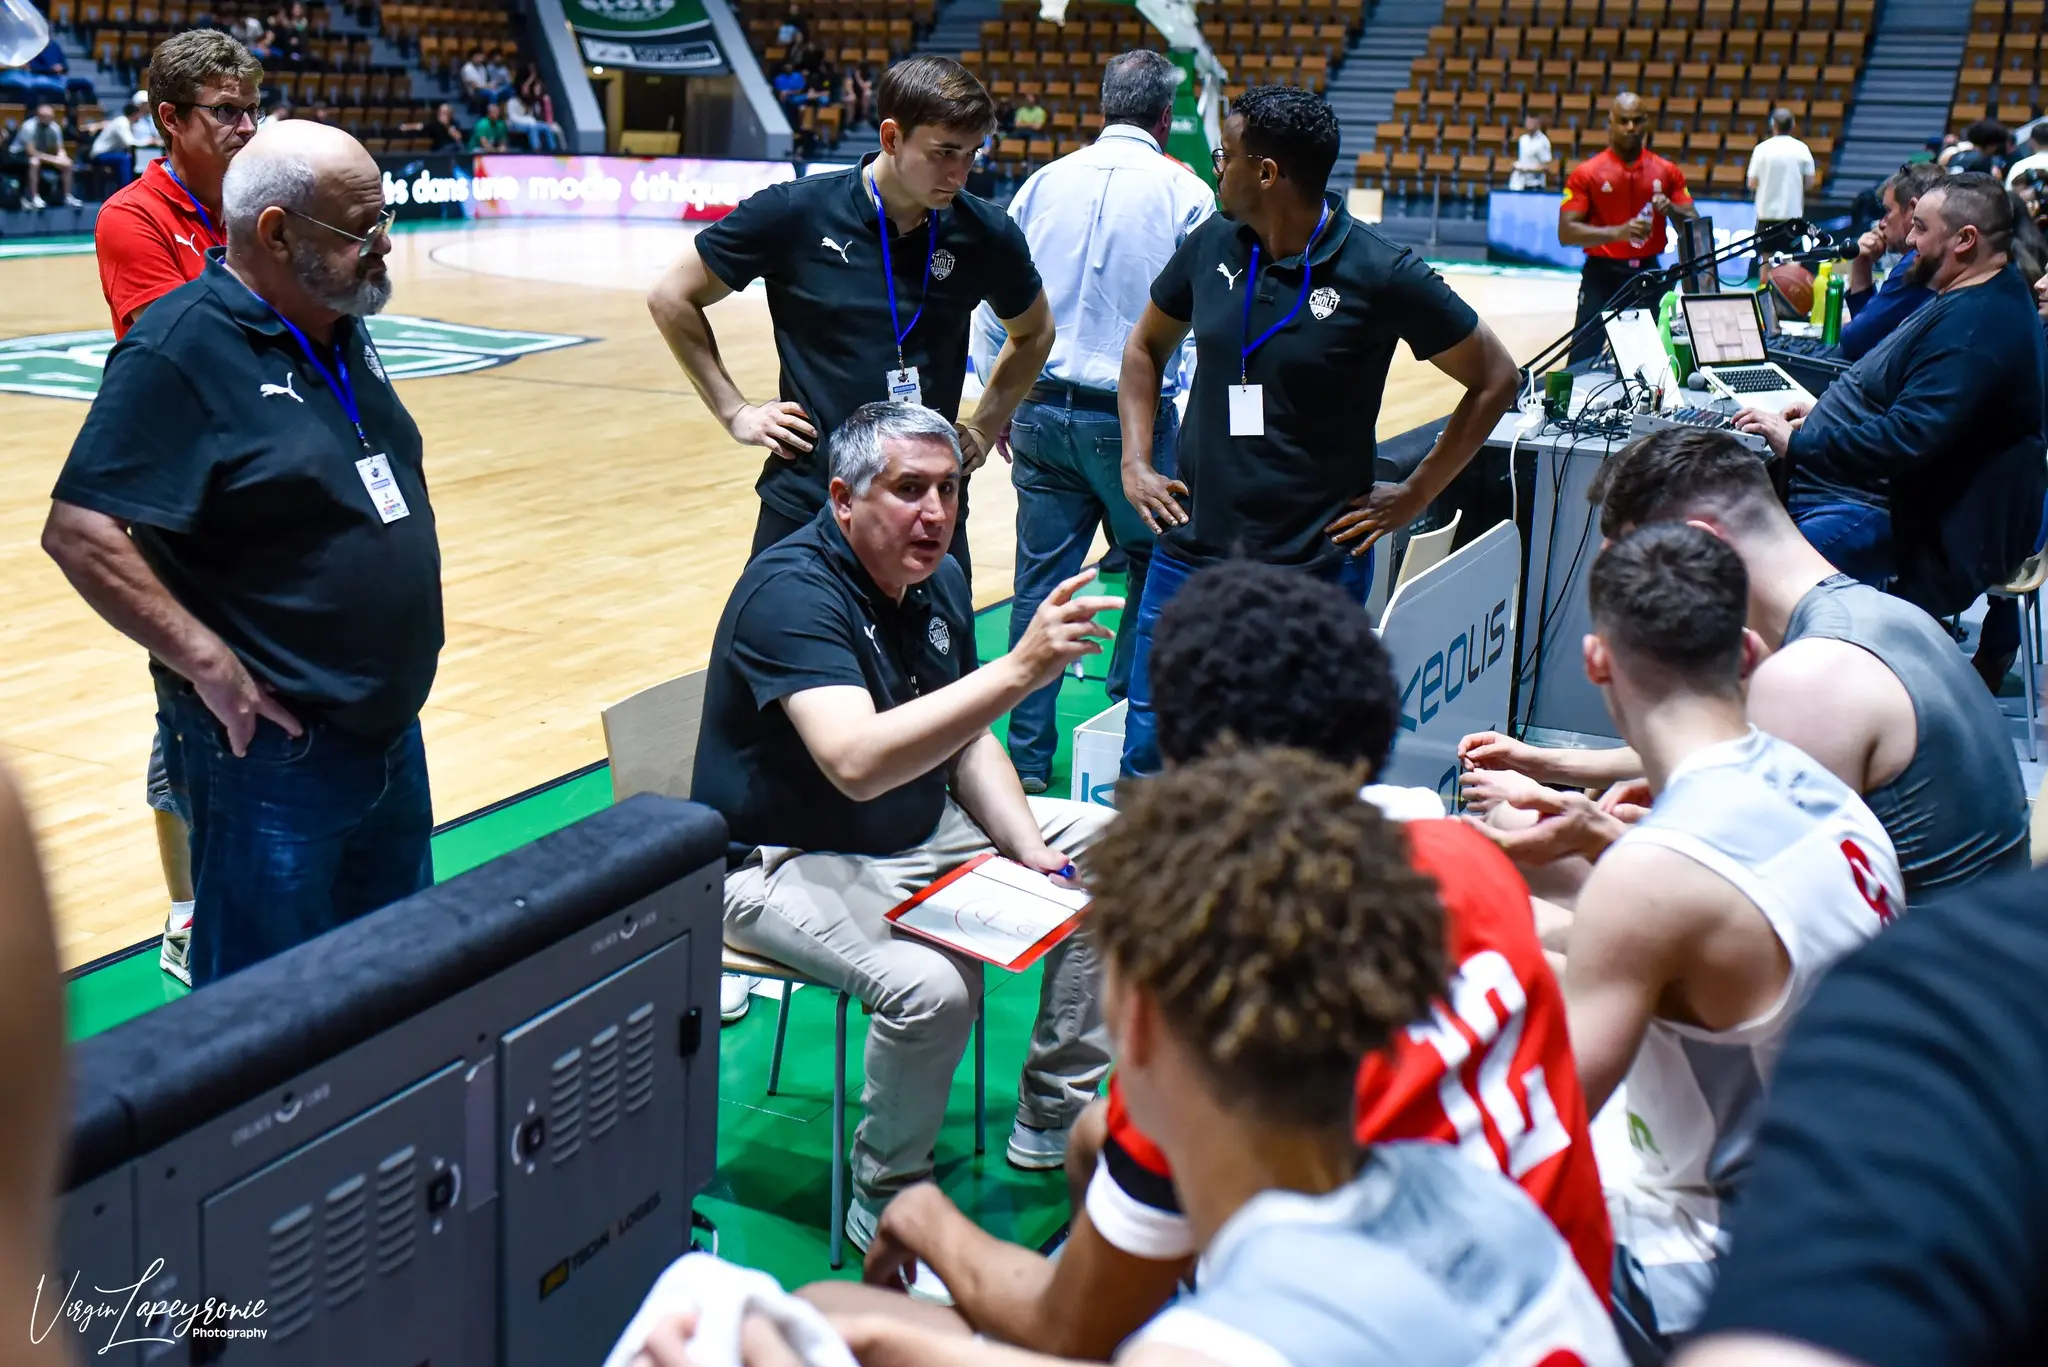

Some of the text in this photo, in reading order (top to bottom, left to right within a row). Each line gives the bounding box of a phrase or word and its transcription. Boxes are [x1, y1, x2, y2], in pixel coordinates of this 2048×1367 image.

[412, 169, 470, 204] dans
[472, 176, 520, 202] une
[528, 169, 622, 202] mode
[1309, 292, 1341, 311] CHOLET
